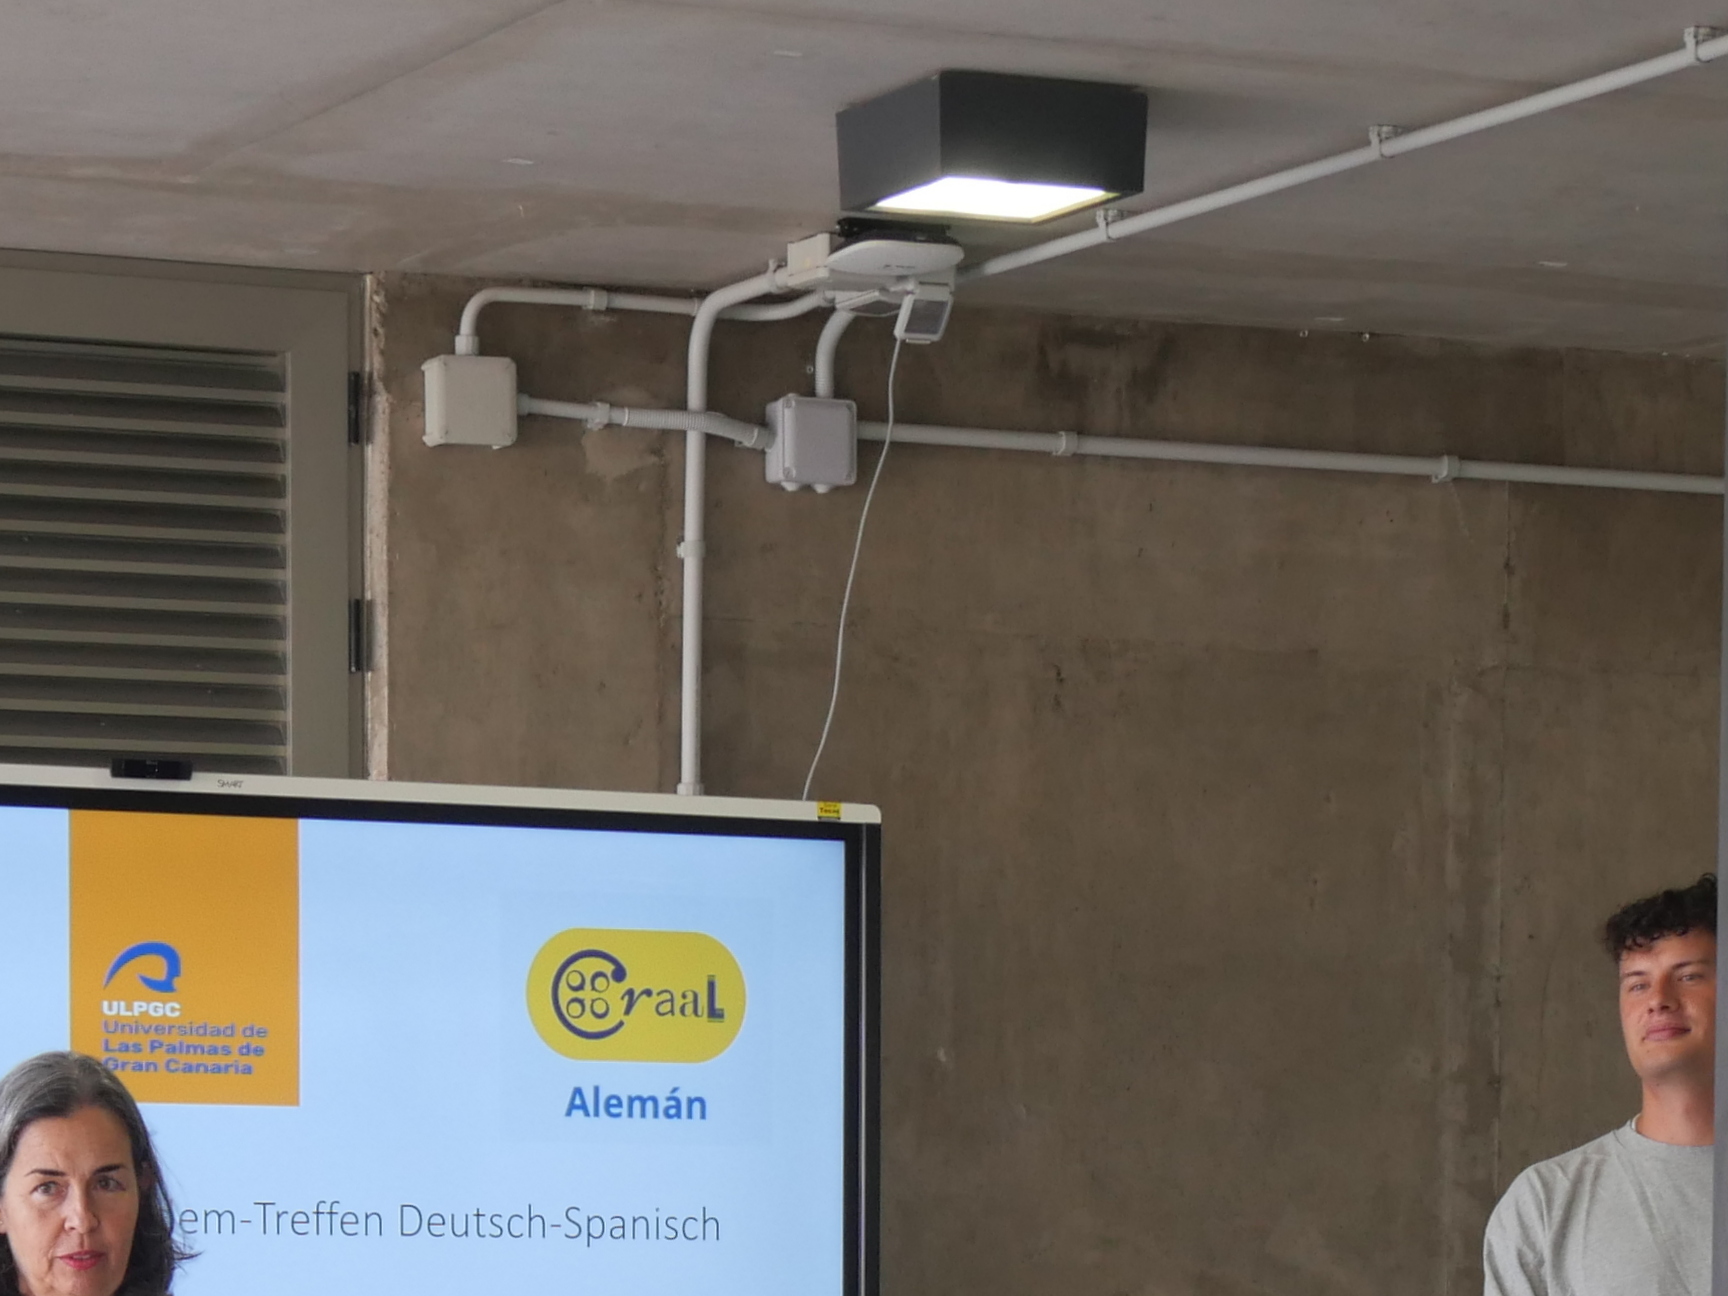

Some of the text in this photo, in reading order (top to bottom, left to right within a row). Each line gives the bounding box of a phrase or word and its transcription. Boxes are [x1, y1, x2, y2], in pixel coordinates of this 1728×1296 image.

[102, 1000, 181, 1017] ULPGC
[103, 1020, 268, 1038] Universidad de
[103, 1039, 265, 1056] Las Palmas de
[102, 1056, 253, 1075] Gran Canaria
[565, 1085, 707, 1120] Alemán
[399, 1203, 721, 1247] Deutsch-Spanisch
